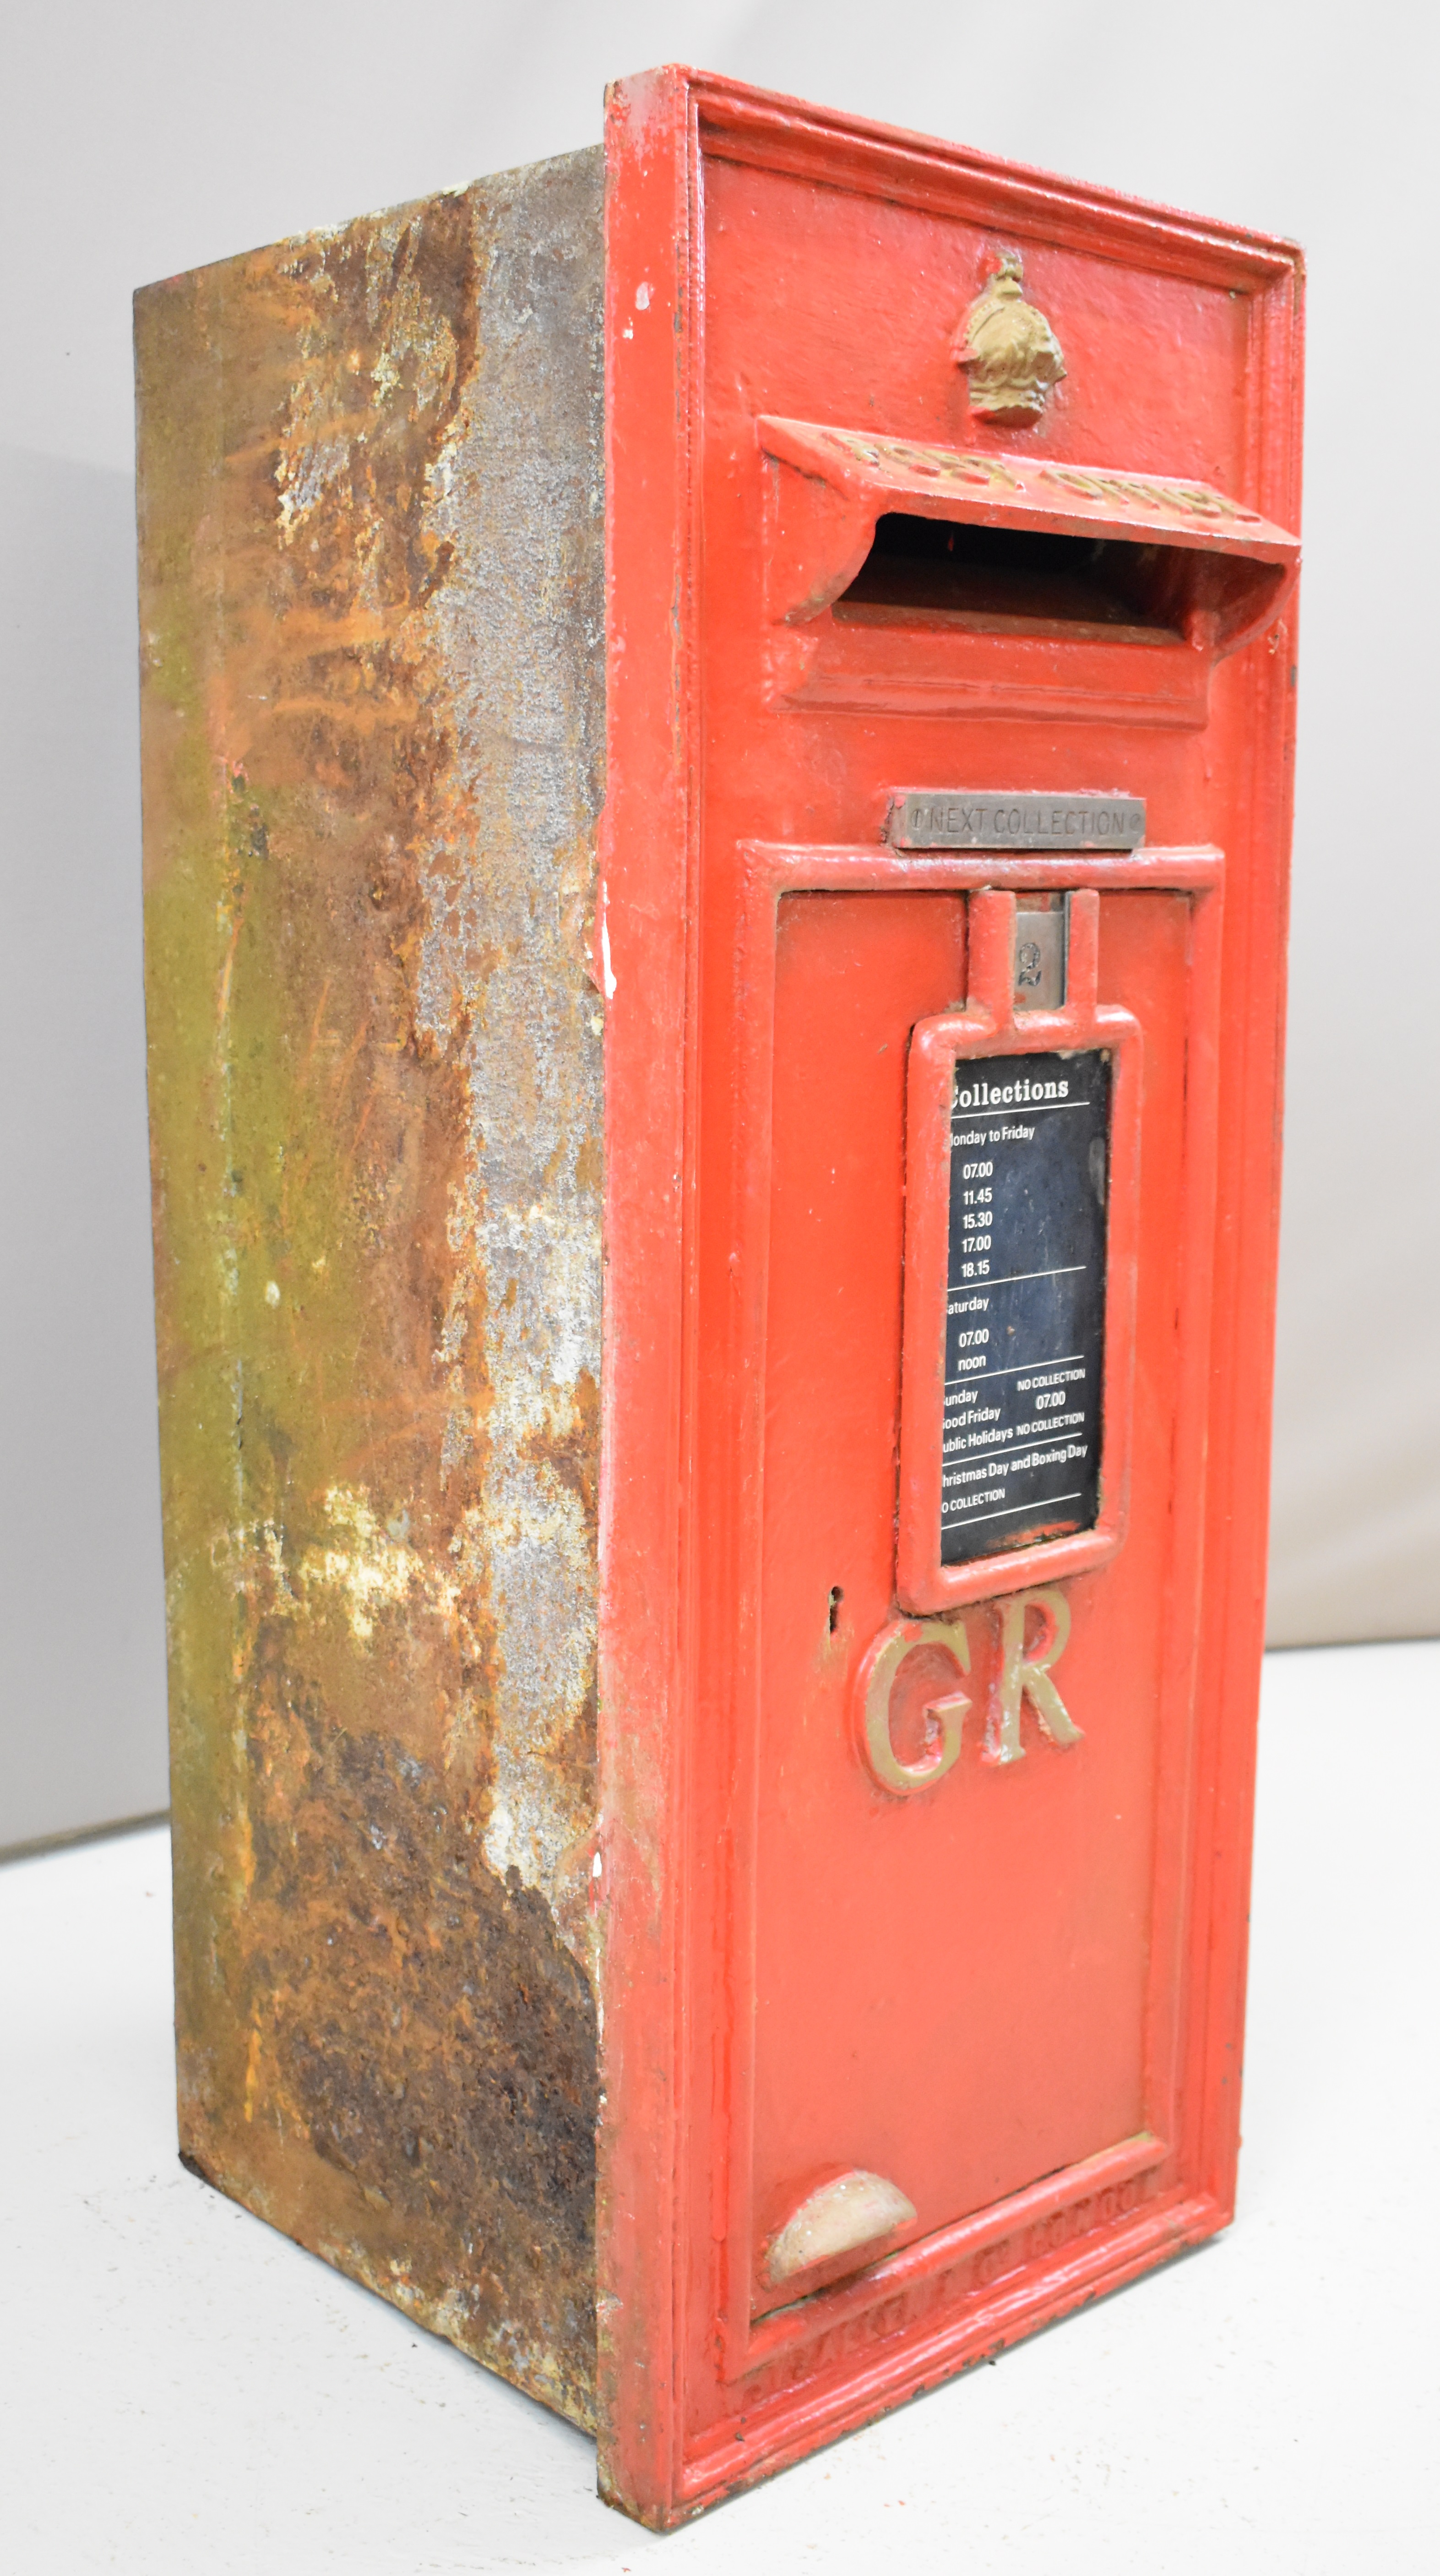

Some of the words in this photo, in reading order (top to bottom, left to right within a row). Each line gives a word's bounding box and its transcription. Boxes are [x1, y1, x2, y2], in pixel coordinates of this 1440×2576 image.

[821, 432, 1026, 492] POST
[1038, 467, 1262, 523] OFFICE
[931, 807, 988, 833] NEXT
[994, 809, 1125, 835] COLLECTION
[1018, 942, 1041, 986] 2
[989, 1130, 1000, 1142] to
[1002, 1125, 1035, 1141] Friday
[962, 1161, 993, 1180] 07.00
[963, 1187, 993, 1205] 11.45
[962, 1211, 993, 1229] 15.30
[962, 1236, 992, 1253] 17.00
[961, 1260, 990, 1278] 18.15
[946, 1296, 989, 1315] aturday
[958, 1329, 989, 1348] 07.00
[957, 1355, 986, 1371] noon
[944, 1389, 978, 1406] unday
[1016, 1379, 1031, 1391] NO
[1032, 1368, 1086, 1389] COLLECTION
[943, 1411, 967, 1429] ood
[967, 1407, 1001, 1424] Friday
[1036, 1391, 1066, 1410] 07.00
[943, 1437, 967, 1453] ublic
[968, 1428, 1013, 1447] Holidays
[1016, 1423, 1030, 1436] NO
[1031, 1412, 1085, 1433] COLLECTION
[942, 1468, 987, 1488] hristmas
[988, 1463, 1009, 1476] Day
[1011, 1454, 1031, 1471] and
[1032, 1449, 1067, 1467] Boxing
[1067, 1444, 1088, 1458] Day
[950, 1488, 1005, 1511] COLLECTION
[863, 1587, 1087, 1792] GR
